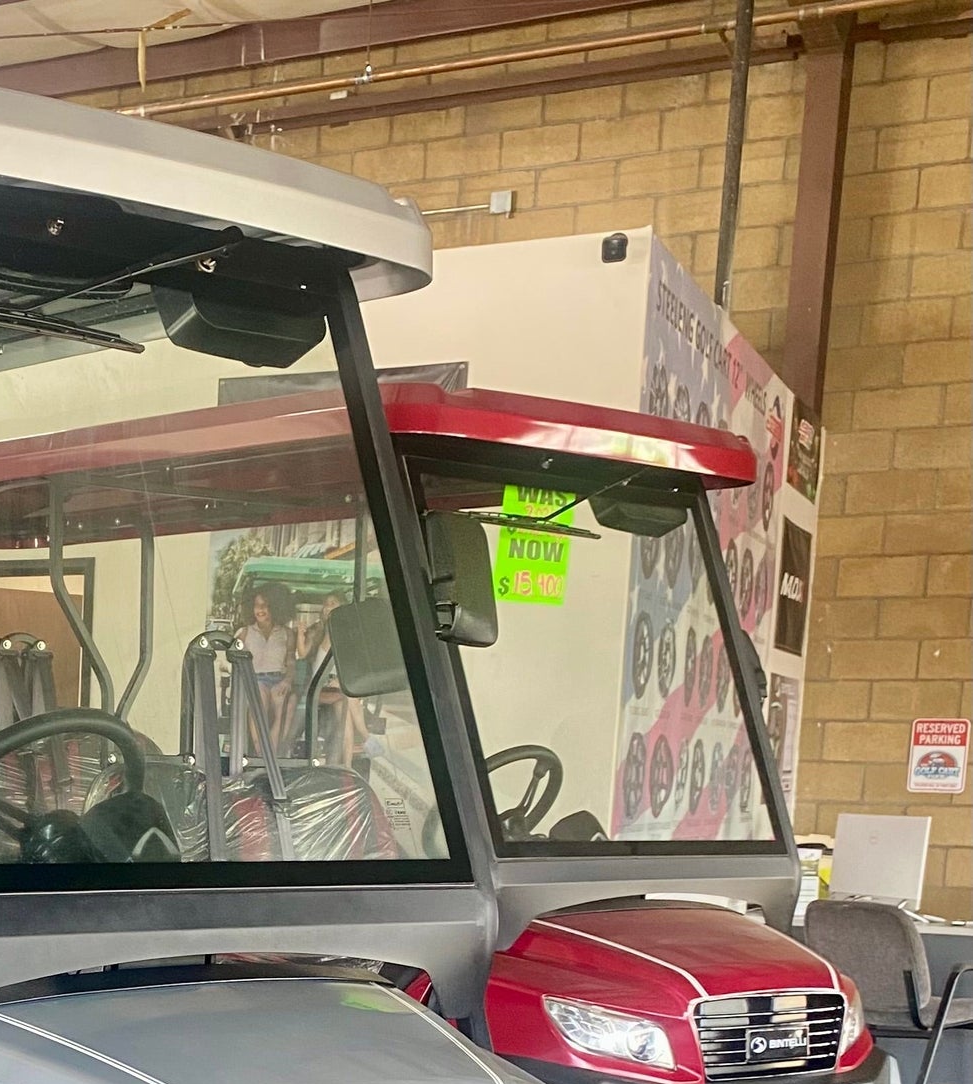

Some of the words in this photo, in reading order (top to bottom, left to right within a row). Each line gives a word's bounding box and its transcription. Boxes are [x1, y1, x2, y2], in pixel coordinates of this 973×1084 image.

[696, 320, 713, 358] GOLF
[714, 341, 732, 373] CART
[518, 486, 567, 507] WAS
[509, 538, 564, 562] NOW
[916, 722, 966, 734] RESERVED
[919, 734, 961, 745] PARKING
[769, 1037, 807, 1049] BINTELLI
